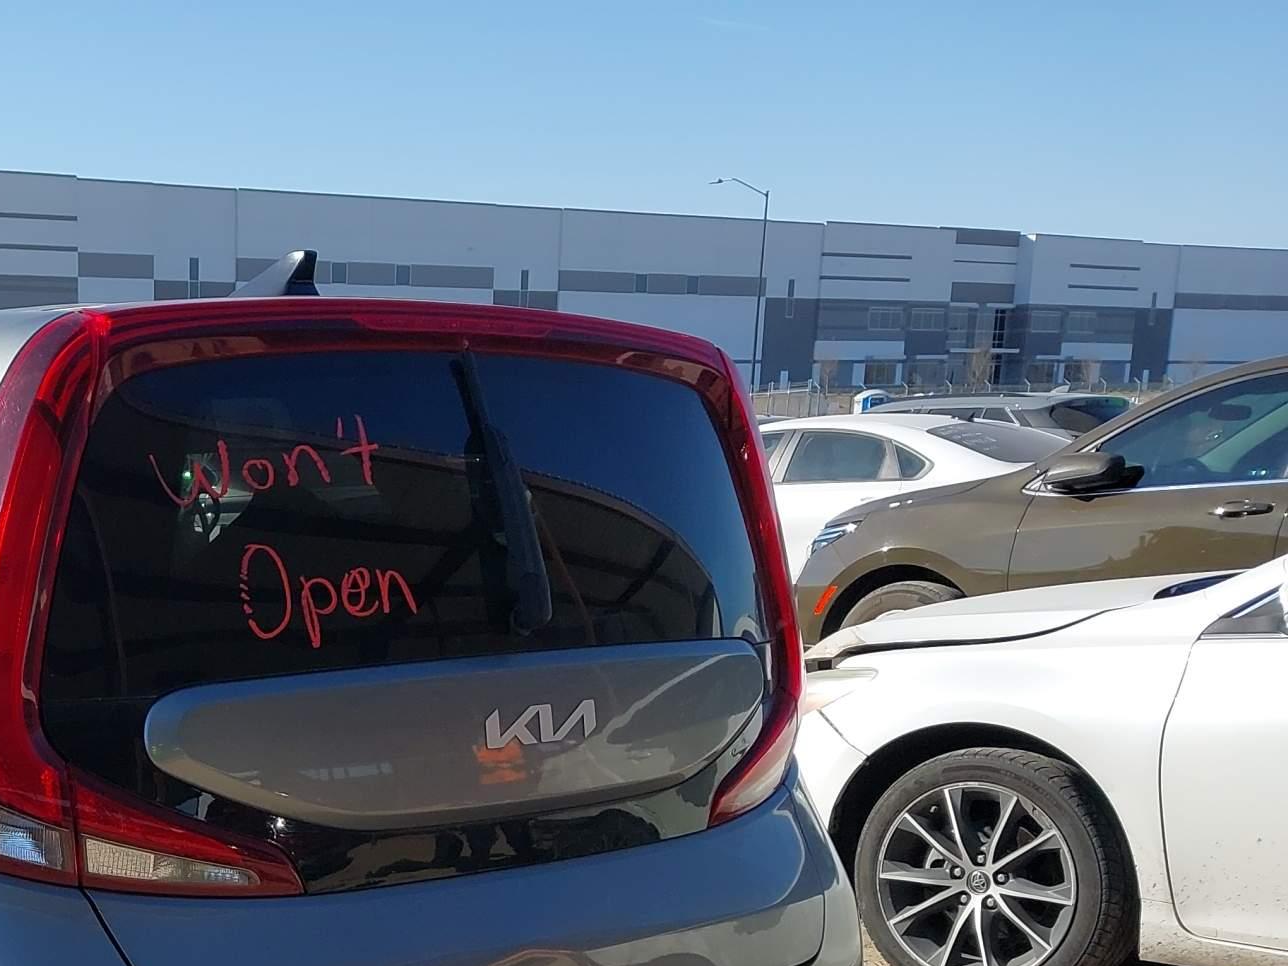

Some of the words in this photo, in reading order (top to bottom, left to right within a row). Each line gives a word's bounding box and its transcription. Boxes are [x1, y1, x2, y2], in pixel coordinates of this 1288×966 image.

[148, 414, 379, 508] Won't
[239, 544, 417, 648] Open
[485, 699, 597, 749] KIA
